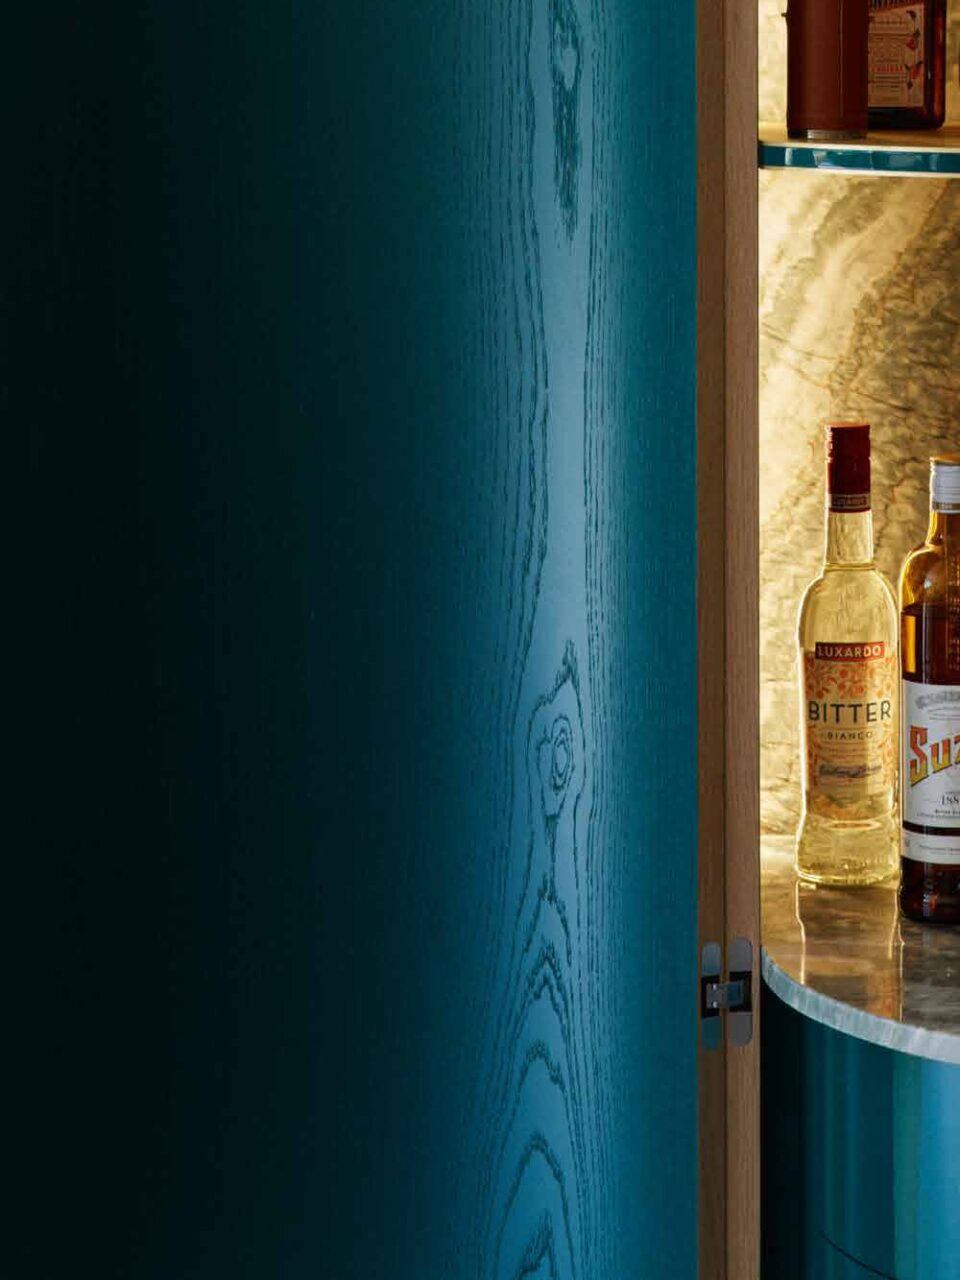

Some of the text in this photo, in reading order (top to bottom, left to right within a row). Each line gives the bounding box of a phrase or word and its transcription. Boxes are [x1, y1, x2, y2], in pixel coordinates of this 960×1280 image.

[817, 644, 882, 659] LUXARDO
[808, 700, 892, 724] BITTER
[826, 730, 873, 742] BIANCO
